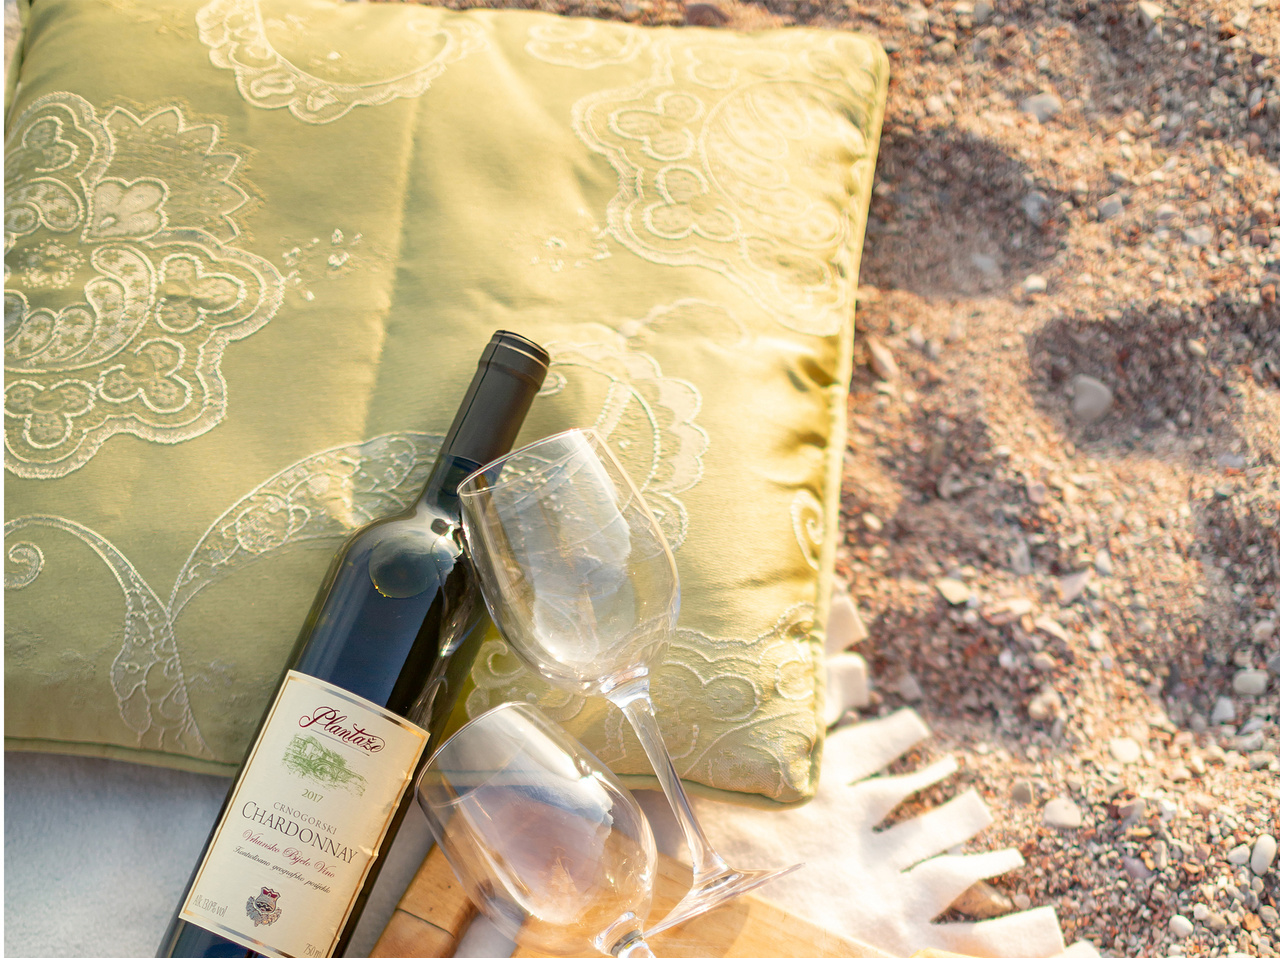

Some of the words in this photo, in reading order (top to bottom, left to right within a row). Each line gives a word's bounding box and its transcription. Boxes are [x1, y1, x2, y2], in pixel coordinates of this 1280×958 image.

[298, 706, 385, 753] Plantaže
[301, 788, 324, 803] 2017
[242, 801, 358, 864] CHARDONNAY
[273, 801, 338, 835] CRNOGORSKI
[242, 829, 280, 854] Vrhunsko
[282, 847, 311, 868] Bijelo
[314, 861, 337, 878] Vino
[303, 943, 316, 958] 750
